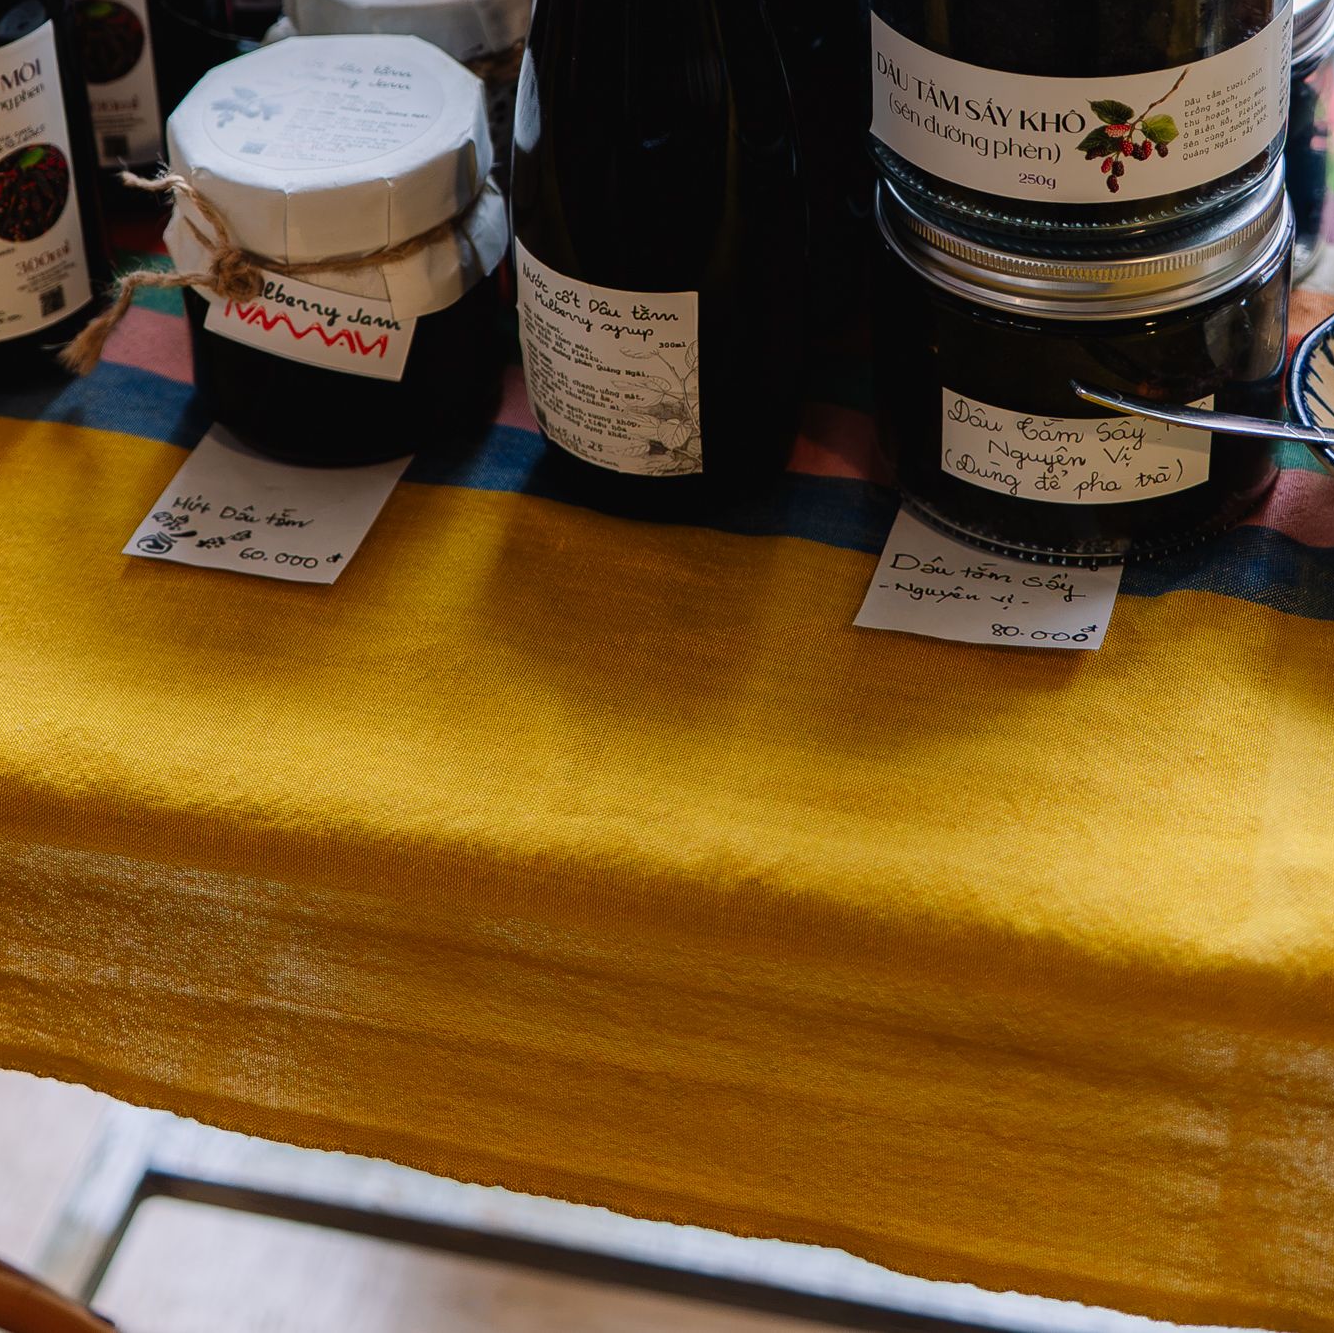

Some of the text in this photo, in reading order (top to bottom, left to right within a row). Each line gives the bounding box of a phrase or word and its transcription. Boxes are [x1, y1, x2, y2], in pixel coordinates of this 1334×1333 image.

[888, 92, 1062, 164] (sên đường phèn)
[1020, 109, 1086, 134] KHÔ
[1018, 172, 1057, 190] 250g
[258, 281, 402, 331] lberry Jam
[523, 262, 679, 321] Nước cốt Dâu tằm
[535, 291, 654, 342] Mulberry syrup
[947, 398, 1003, 433] Dâu
[988, 440, 1133, 474] Nguyên Vị
[1034, 469, 1069, 491] để
[1073, 472, 1122, 499] pha
[219, 506, 260, 523] Dâu
[890, 553, 955, 577] Dâu
